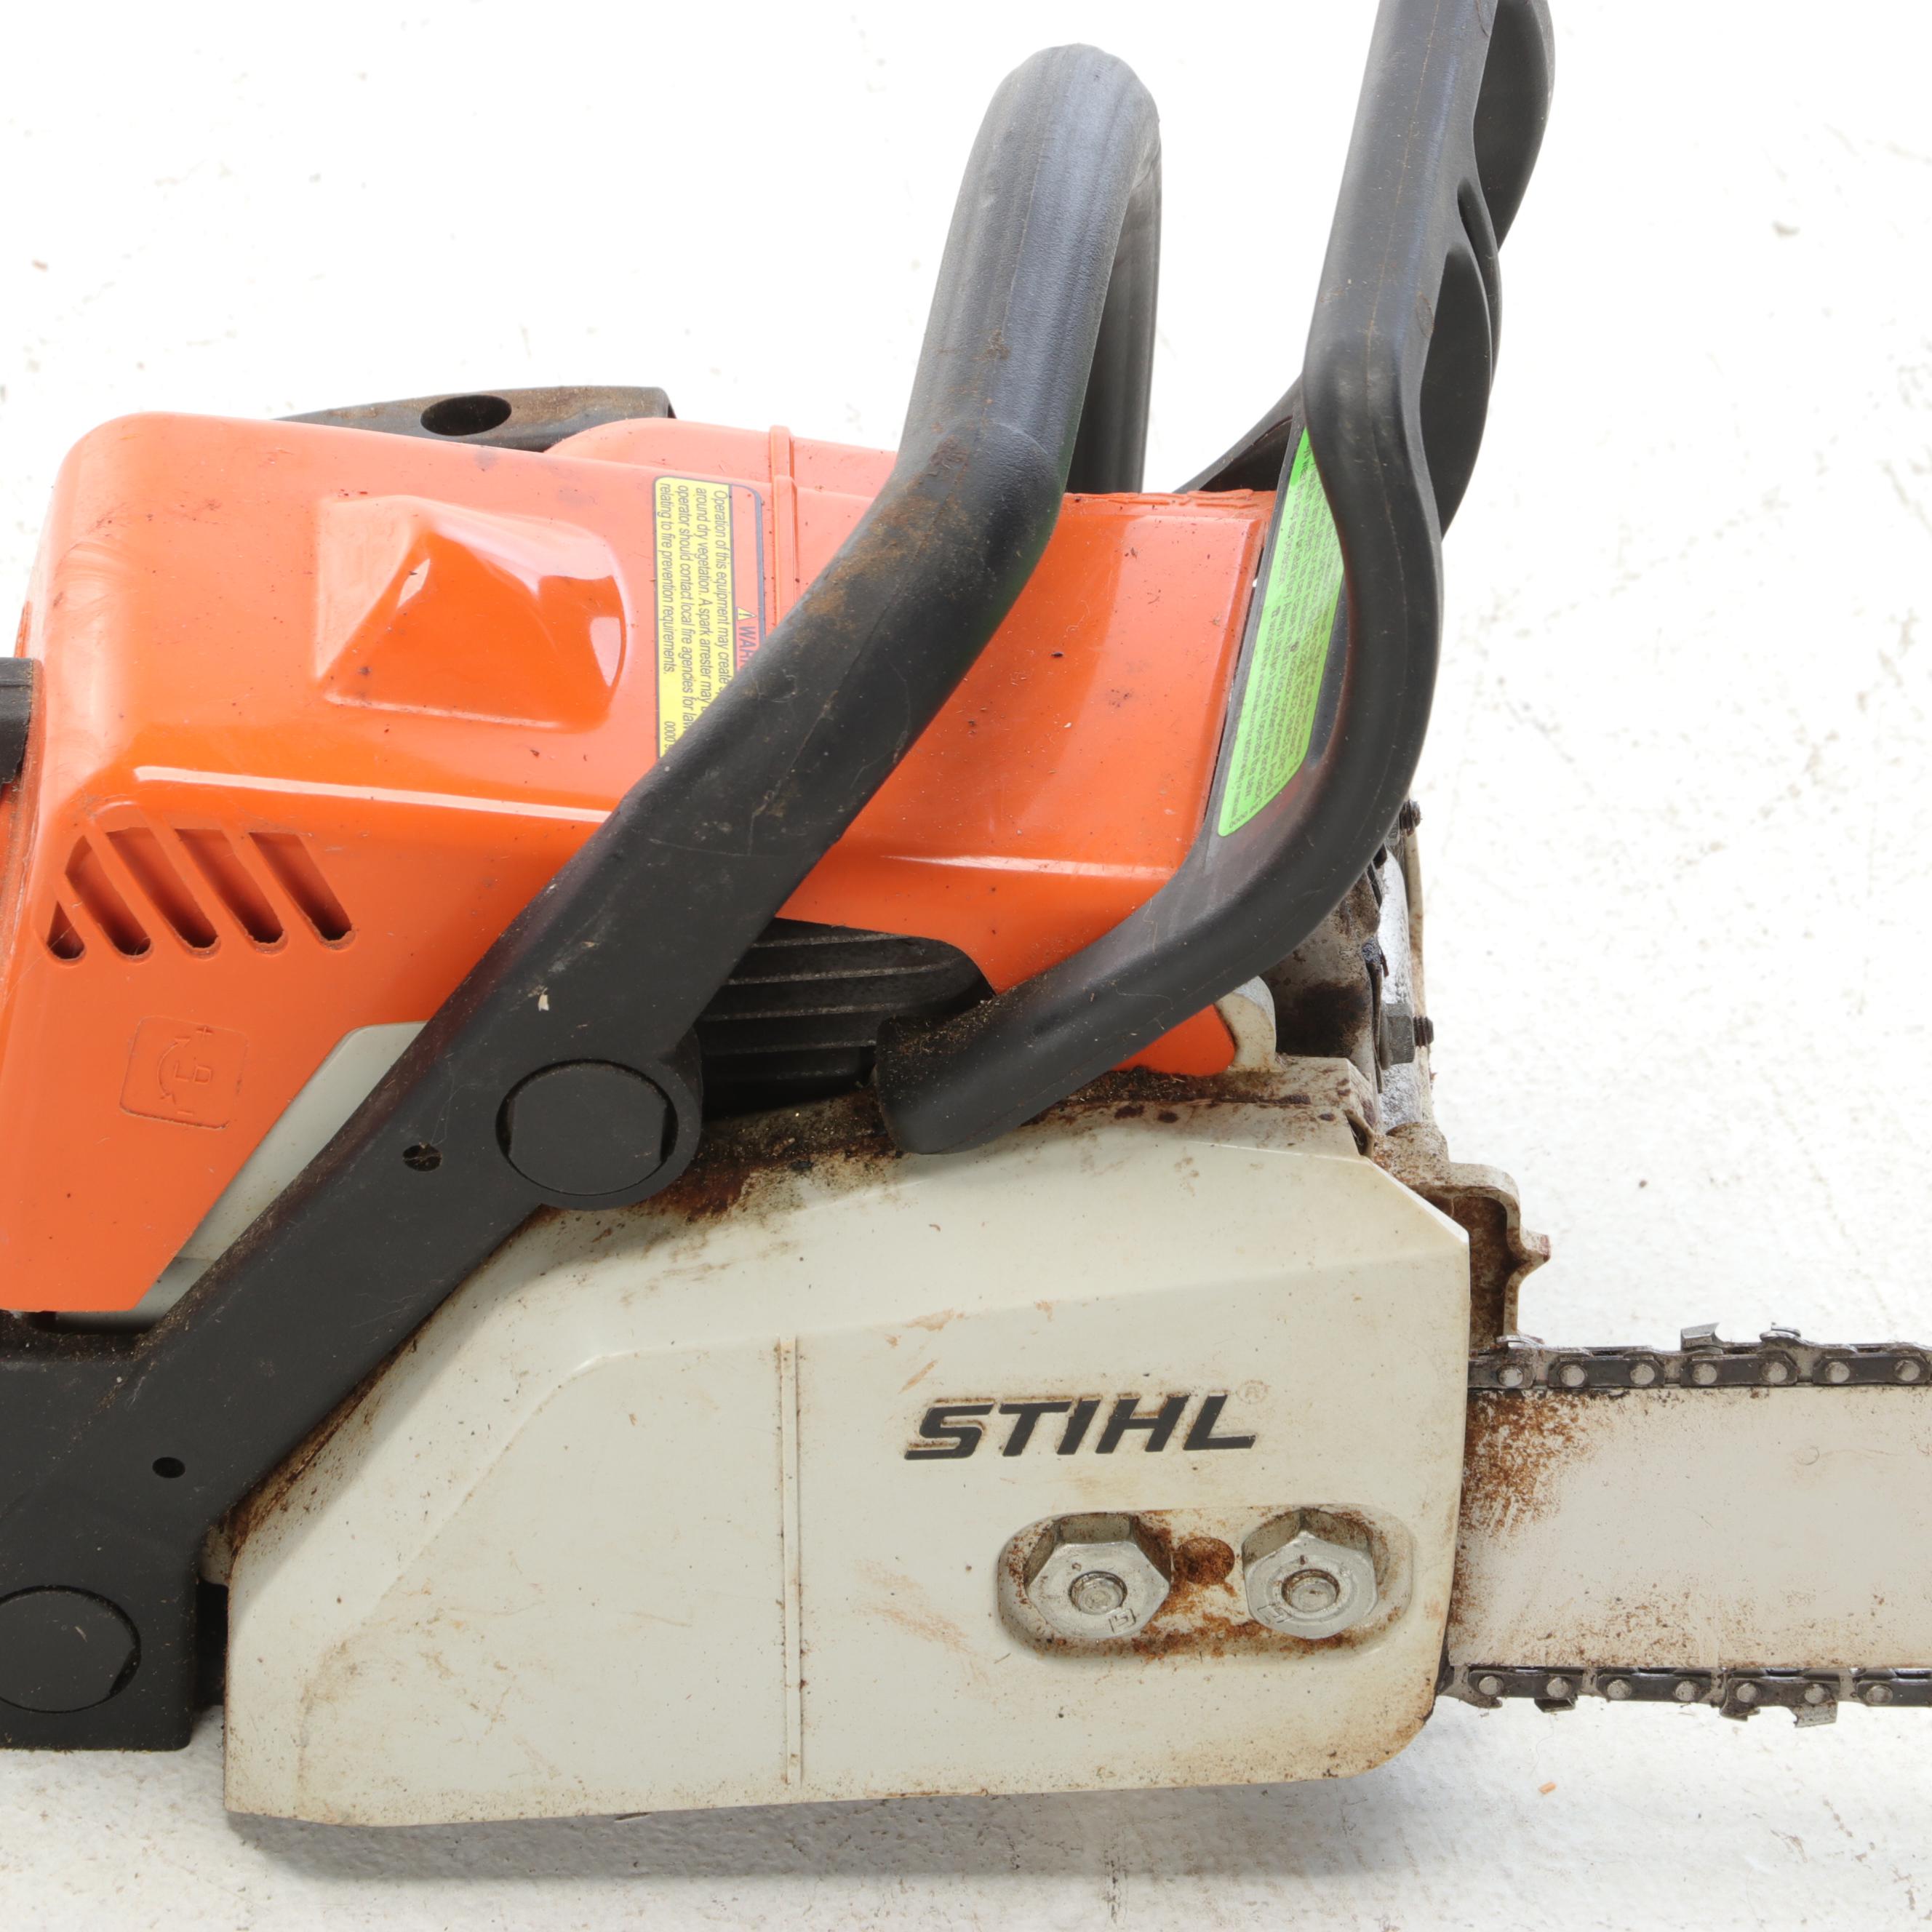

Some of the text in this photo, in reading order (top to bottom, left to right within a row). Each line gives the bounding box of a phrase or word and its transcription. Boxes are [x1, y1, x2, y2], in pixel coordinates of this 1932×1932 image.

[657, 483, 675, 518] relating
[675, 485, 692, 527] operator
[696, 487, 711, 522] around
[711, 490, 728, 538] Operation
[660, 521, 674, 530] to
[660, 533, 675, 548] fire
[694, 524, 711, 540] dry
[679, 528, 693, 561] should
[716, 540, 730, 551] of
[716, 552, 730, 569] this
[658, 551, 676, 602] prevention
[680, 564, 694, 599] contact
[695, 543, 712, 595] vegetation.
[681, 602, 695, 626] local
[698, 598, 713, 606] A
[713, 572, 731, 625] equipment
[681, 628, 695, 644] fire
[695, 608, 714, 636] spark
[659, 605, 676, 674] requirements.
[714, 628, 729, 649] may
[678, 647, 695, 692] agencies
[700, 639, 714, 679] arrester
[718, 652, 732, 684] create
[682, 696, 697, 710] for
[698, 681, 711, 703] may
[664, 722, 676, 742] 0000
[904, 1393, 1256, 1460] STIHL
